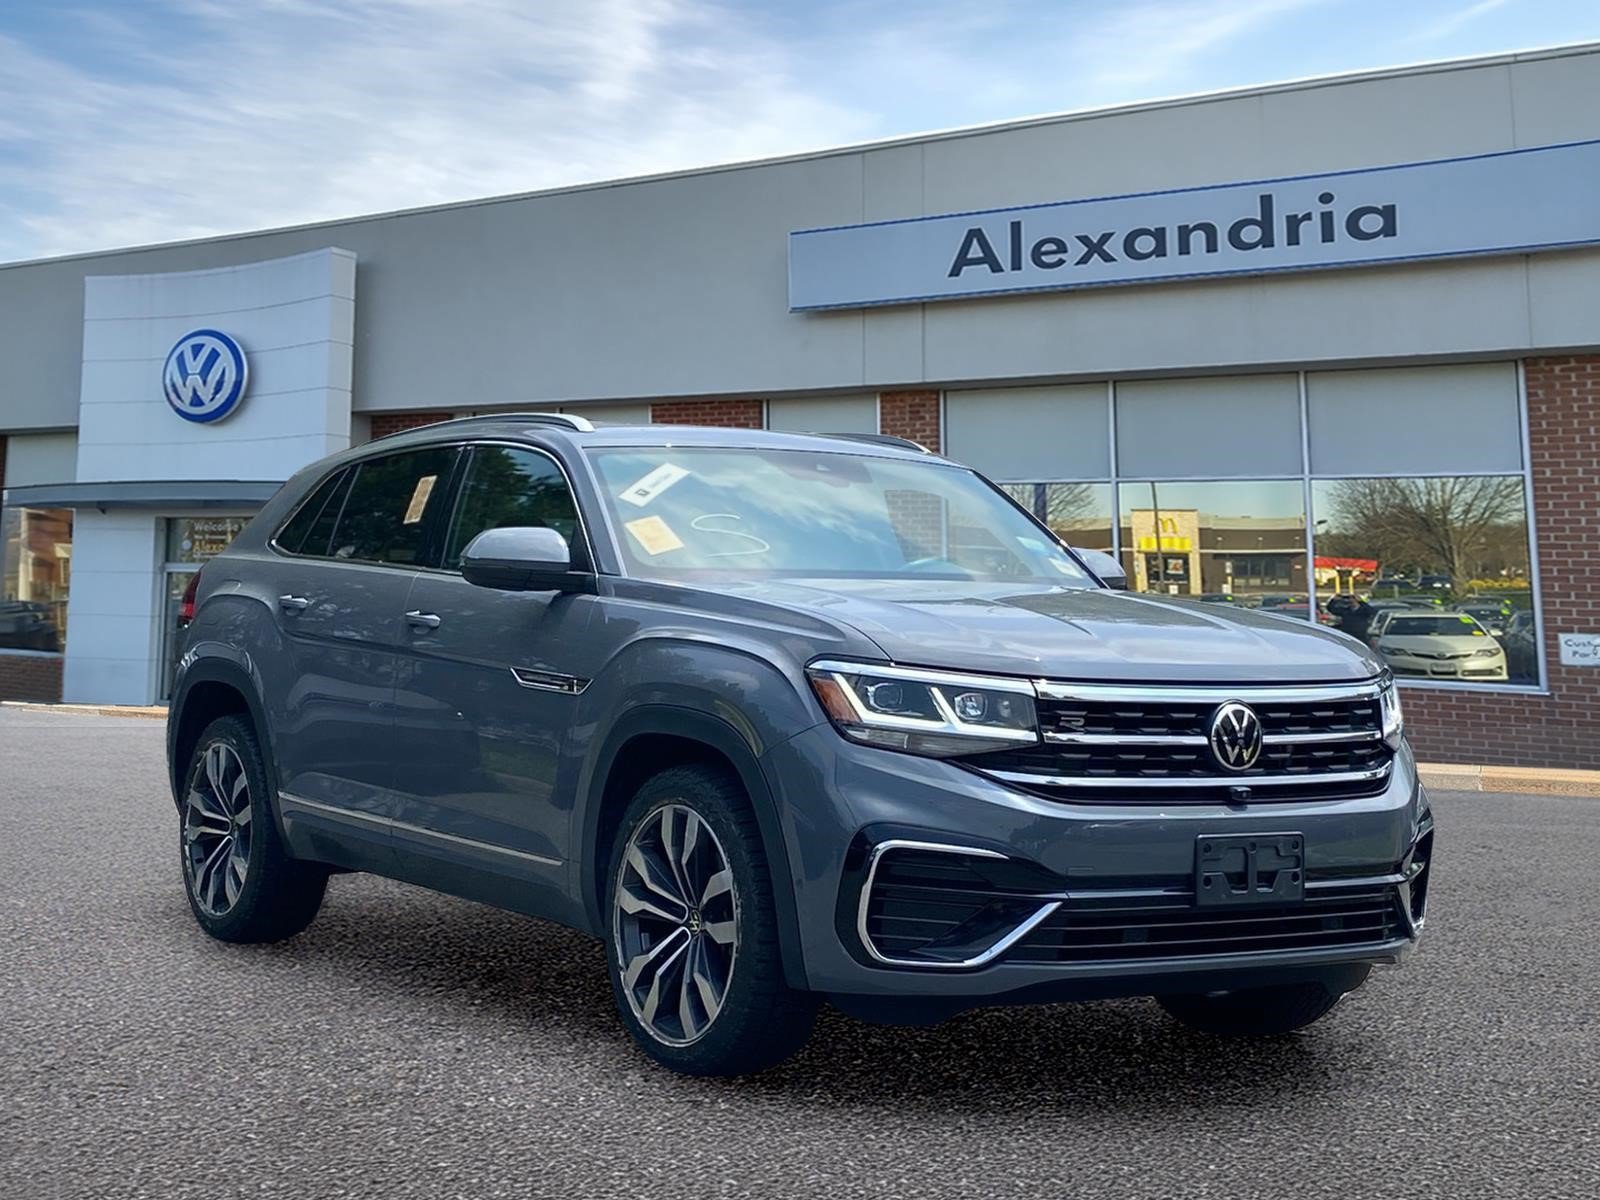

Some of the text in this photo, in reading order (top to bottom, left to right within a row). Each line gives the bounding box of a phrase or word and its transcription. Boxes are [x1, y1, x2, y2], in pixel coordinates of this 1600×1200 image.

[947, 191, 1398, 278] Alexandria
[166, 333, 240, 418] VW
[1212, 702, 1260, 769] VW
